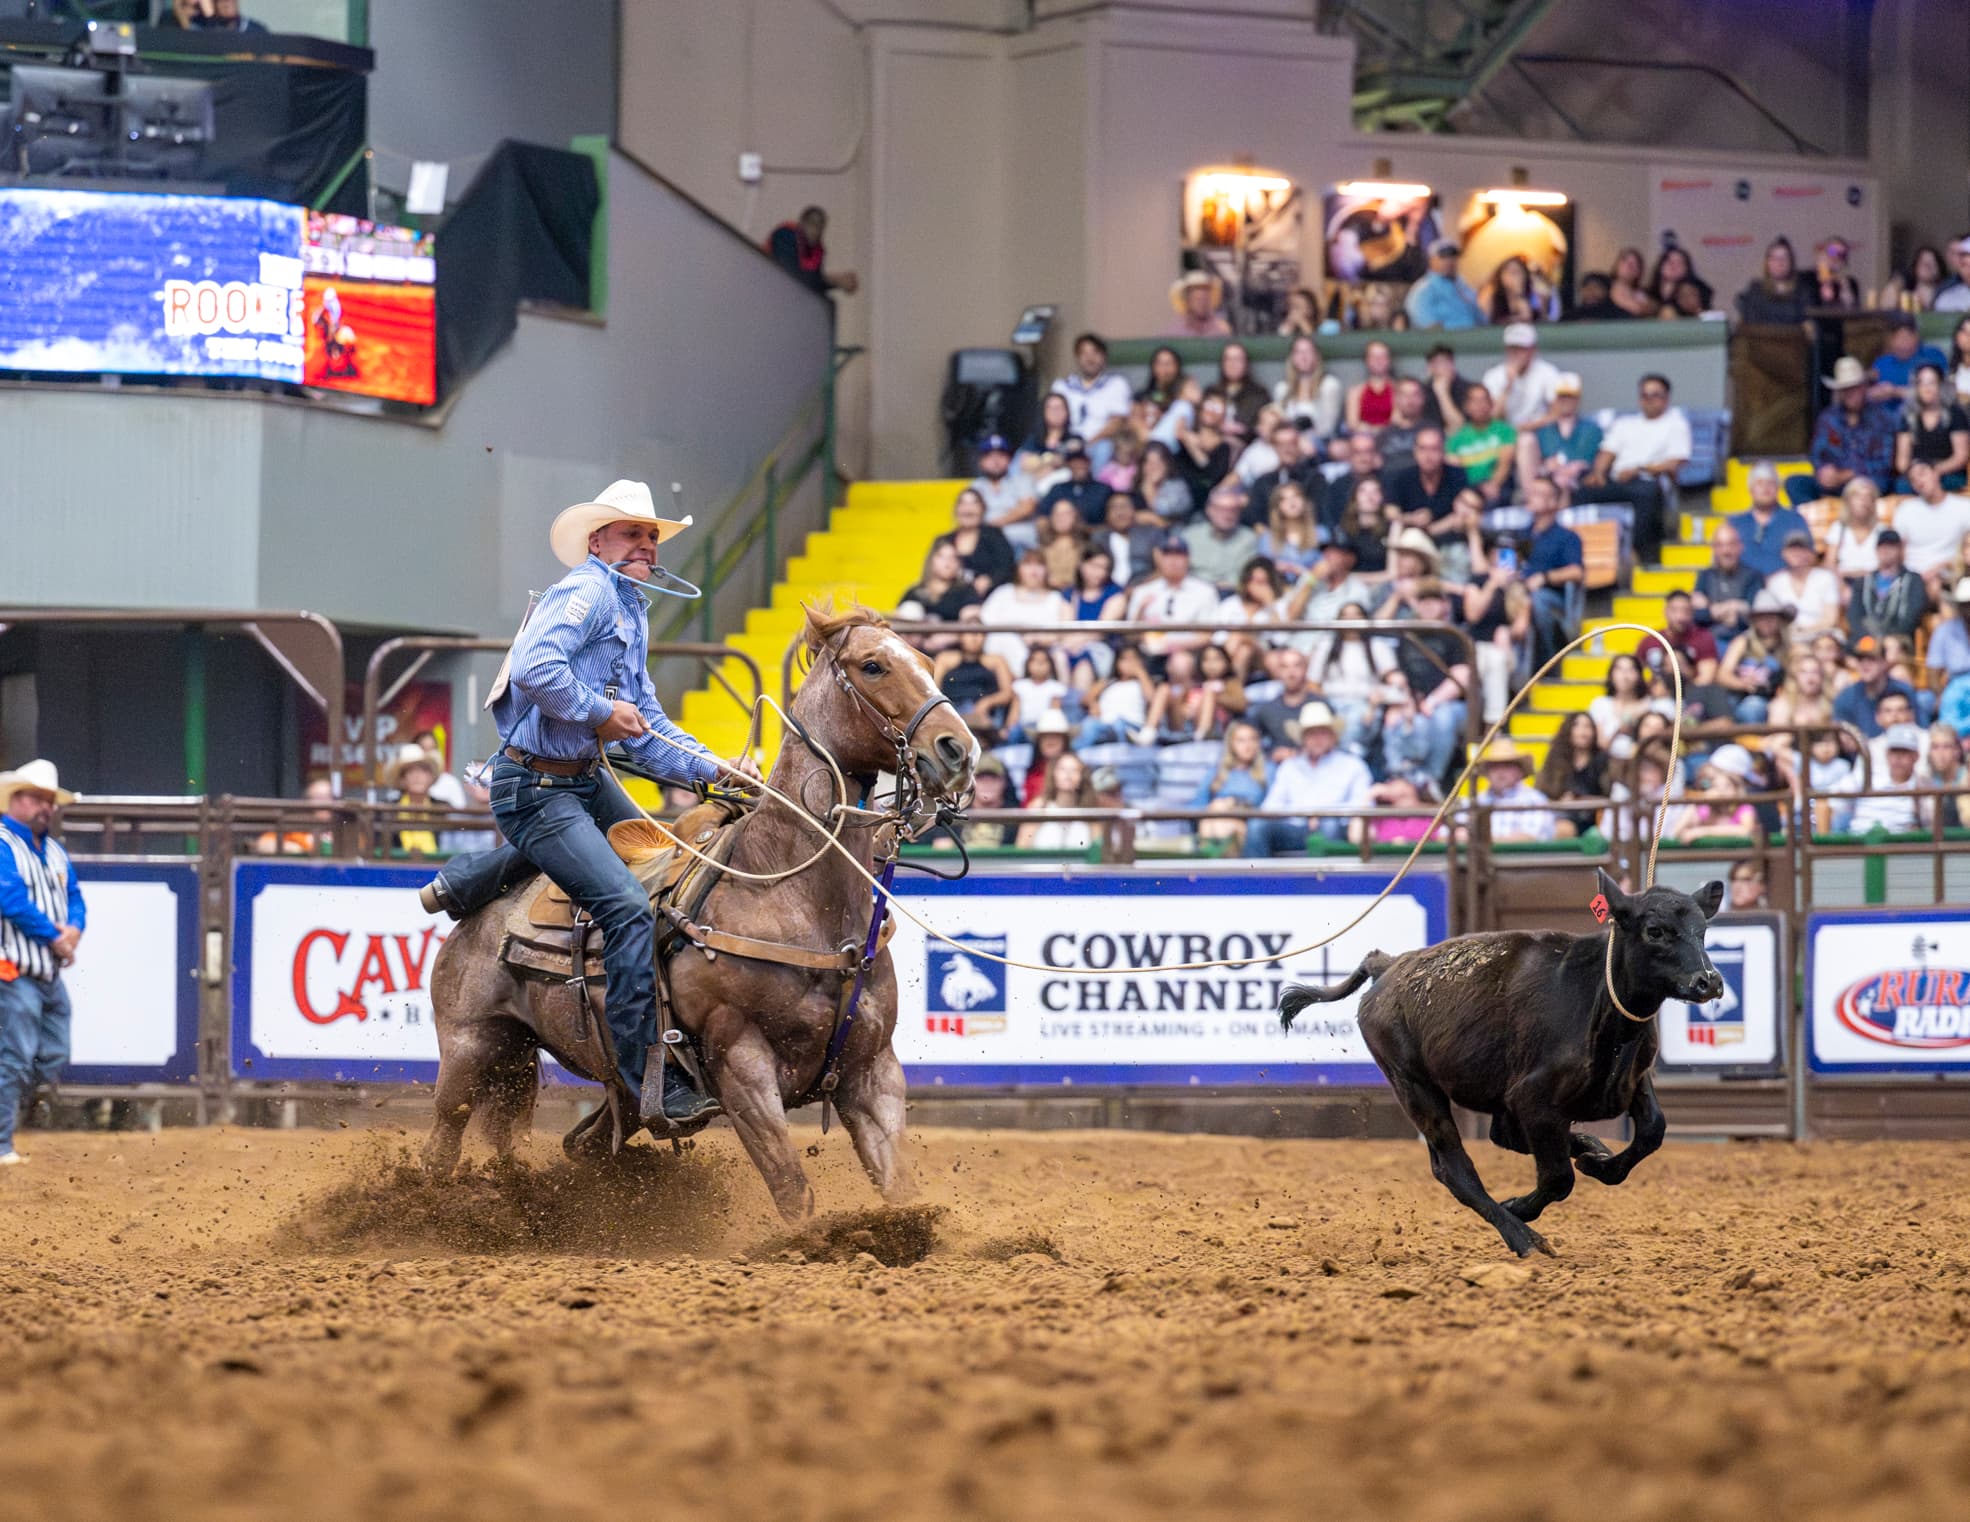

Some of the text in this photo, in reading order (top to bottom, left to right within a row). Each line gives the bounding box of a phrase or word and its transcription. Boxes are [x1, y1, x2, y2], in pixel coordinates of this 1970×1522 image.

[344, 715, 399, 742] VP
[1042, 933, 1292, 971] COWBOY
[292, 925, 447, 1024] CAV
[1877, 969, 1970, 1012] RUR
[1039, 1021, 1354, 1037] LIVE STREAMING ON DMAND
